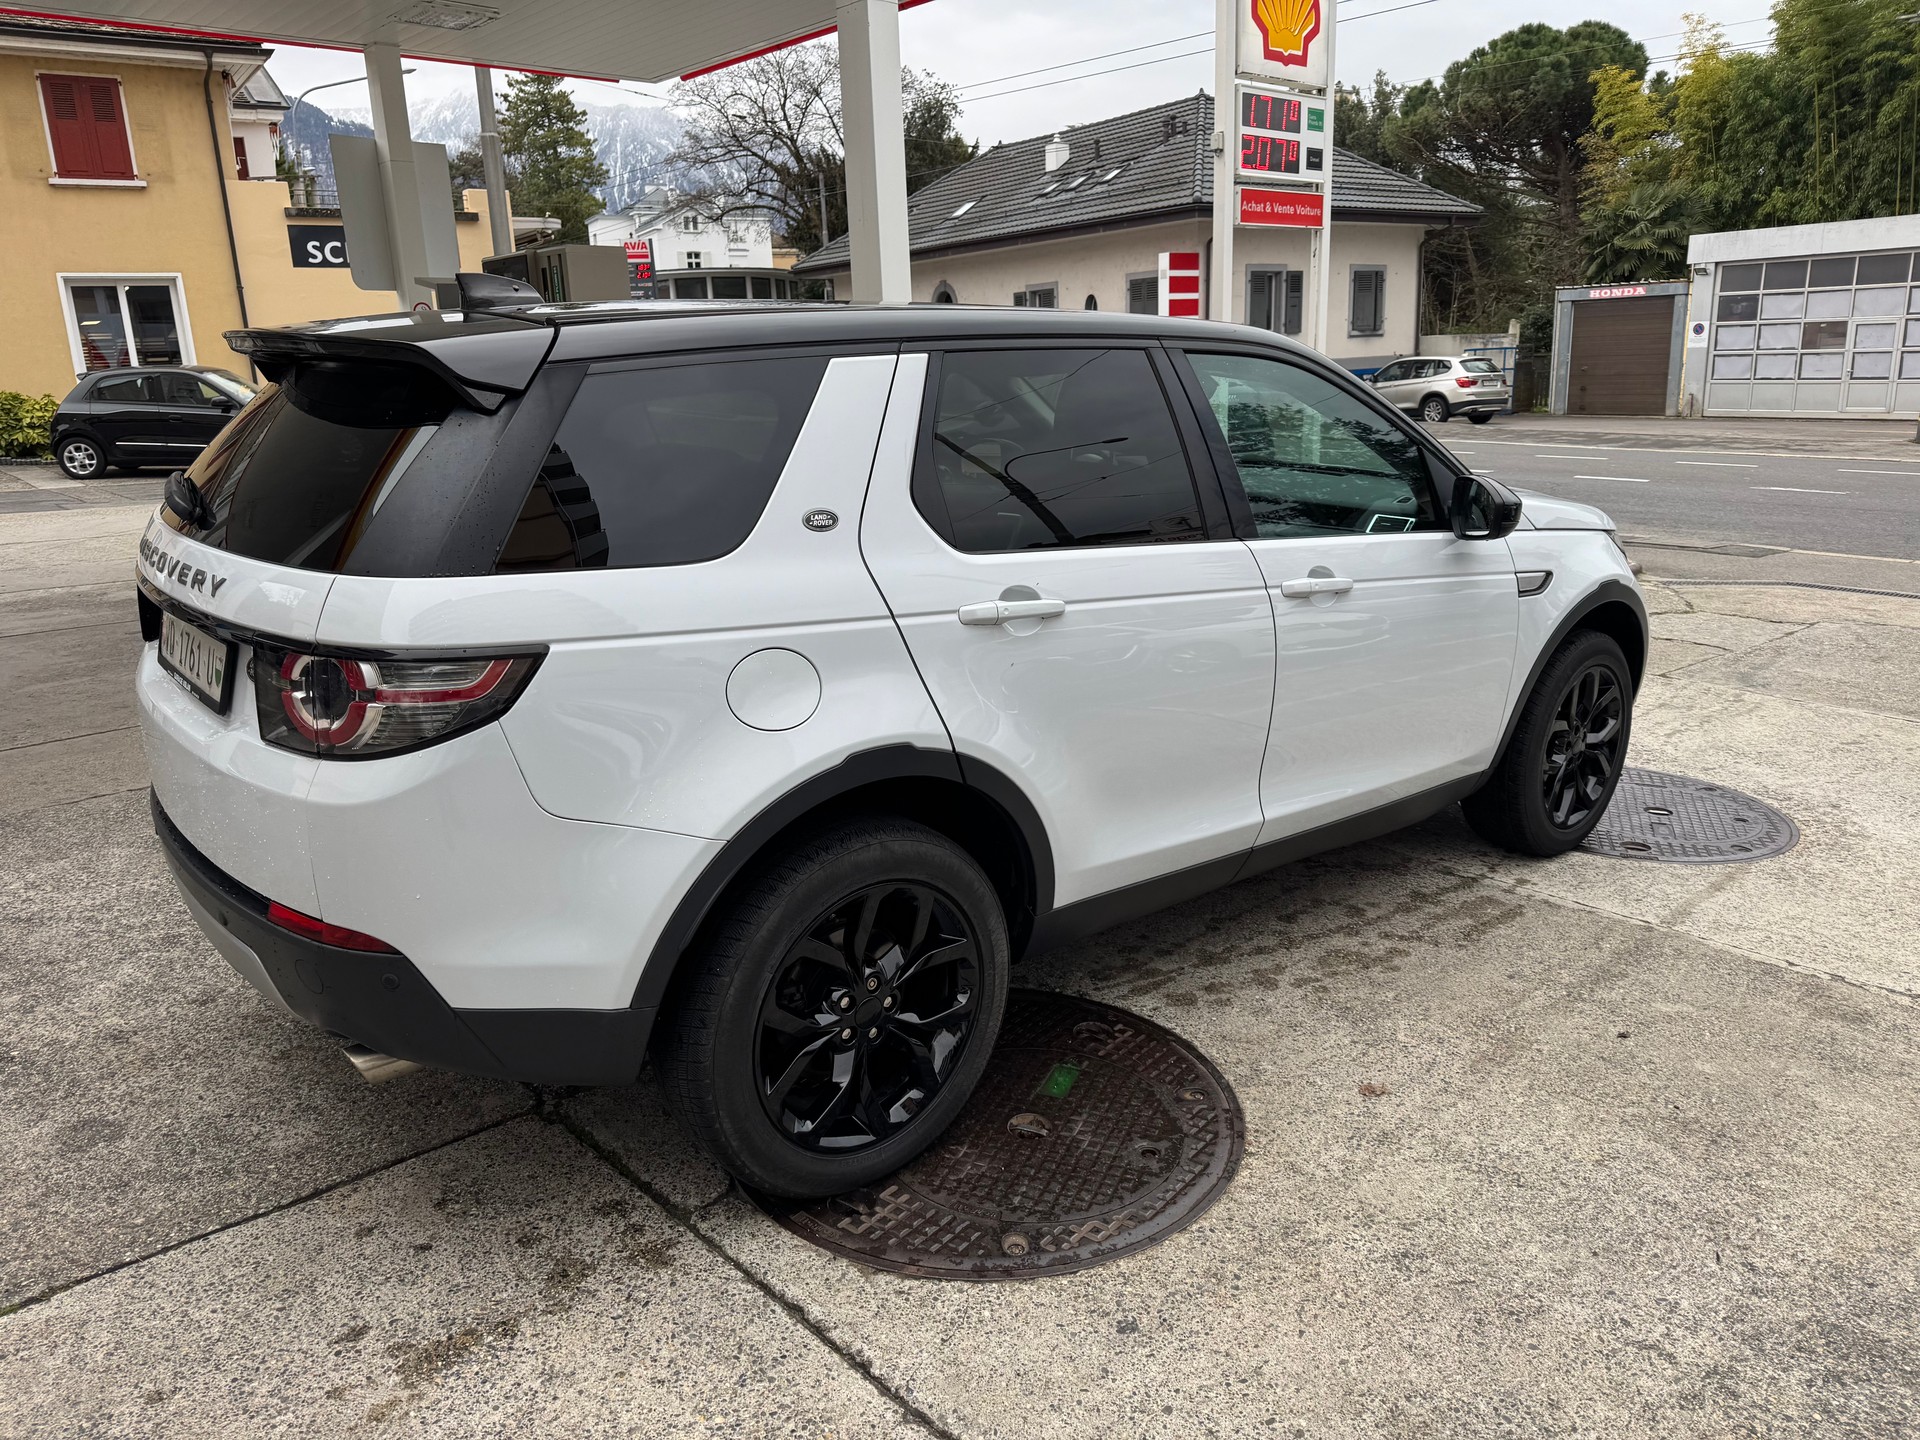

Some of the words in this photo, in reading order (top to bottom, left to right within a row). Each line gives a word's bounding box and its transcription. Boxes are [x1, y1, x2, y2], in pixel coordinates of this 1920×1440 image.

[1241, 200, 1264, 212] Achat
[1265, 202, 1272, 213] &
[1273, 202, 1295, 214] Vente
[1295, 204, 1321, 216] Voiture
[306, 241, 350, 264] SC
[1589, 287, 1646, 298] HONDA
